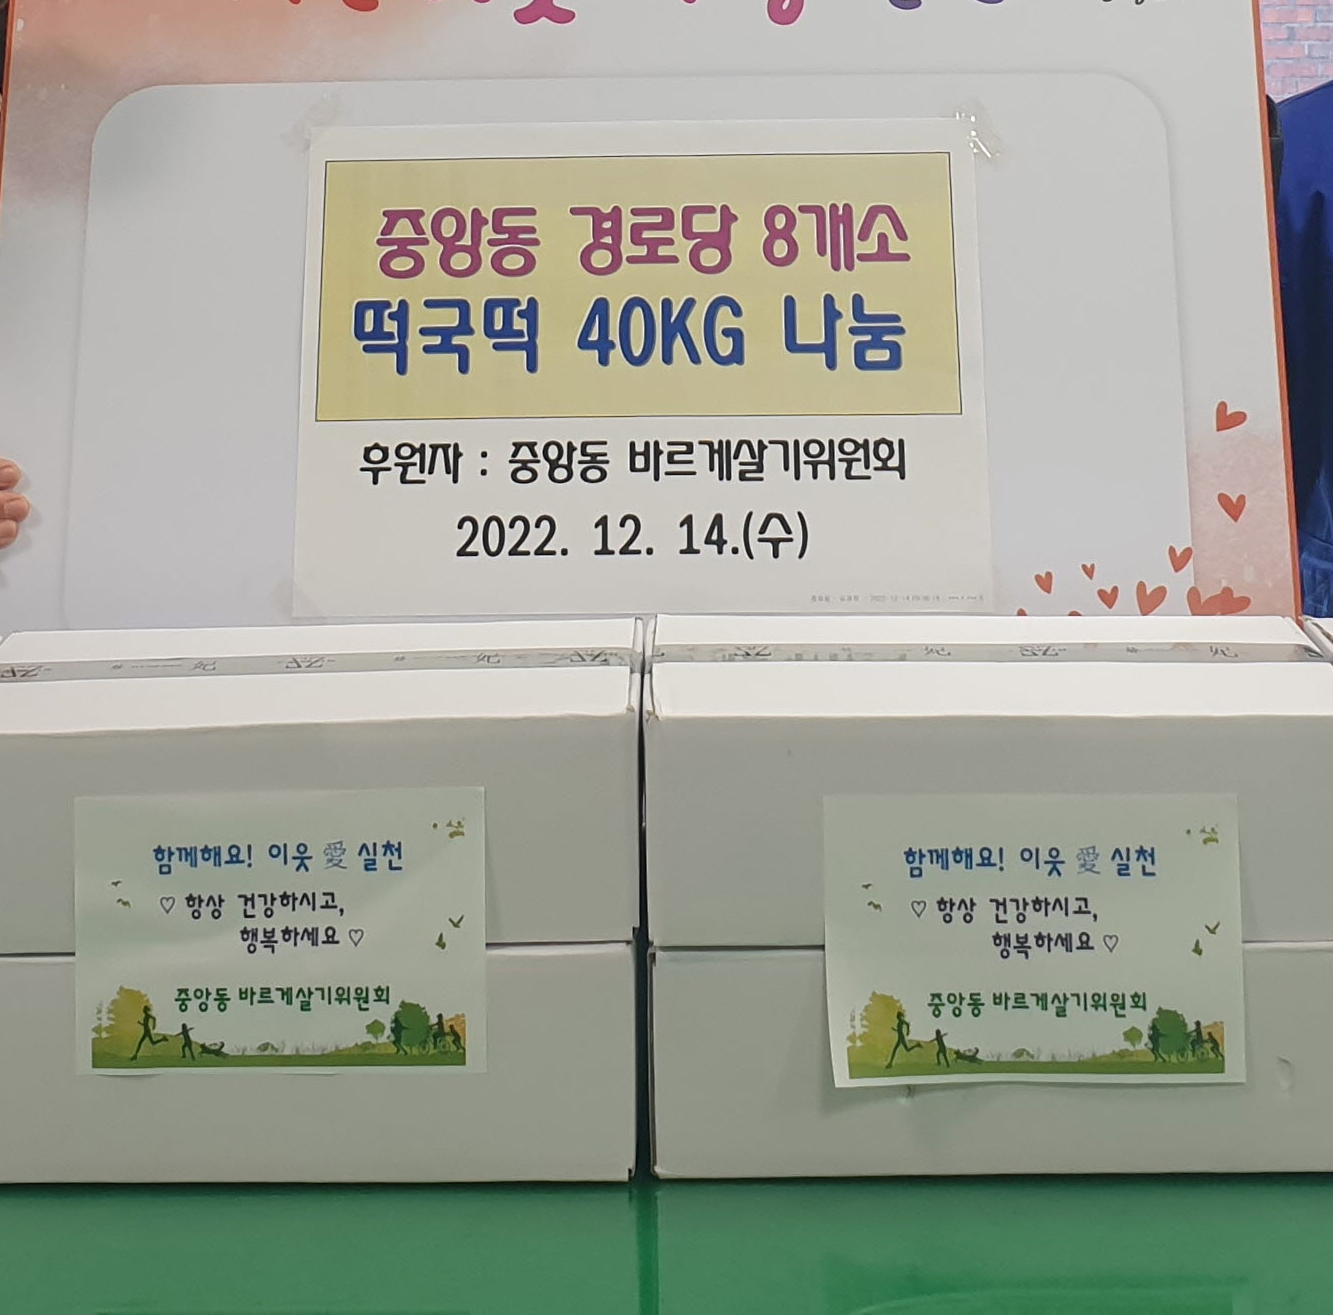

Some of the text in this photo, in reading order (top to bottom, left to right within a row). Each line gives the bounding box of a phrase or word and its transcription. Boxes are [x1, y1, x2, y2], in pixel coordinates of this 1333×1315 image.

[375, 202, 911, 279] 중앙동 경로당 8개소
[353, 292, 906, 376] 떡국떡 40KG 나눔
[360, 443, 463, 485] 후원자
[509, 441, 609, 484] 중앙동
[630, 438, 905, 481] 바르게살기위원회
[456, 511, 808, 560] 2022. 12. 14.(수)
[153, 840, 402, 875] 함께해요! 이웃 愛 실천
[904, 845, 1156, 878] 함께해요! 이웃 愛 실천
[185, 891, 344, 919] 항상 건강하시고,
[936, 896, 1097, 924] 항상 건강하시고,
[240, 926, 340, 954] 행복하세요
[992, 932, 1094, 959] 행복하세요
[175, 986, 389, 1012] 중앙동 바르게살기위원회
[928, 992, 1146, 1018] 중앙동 바르게살기위원회
